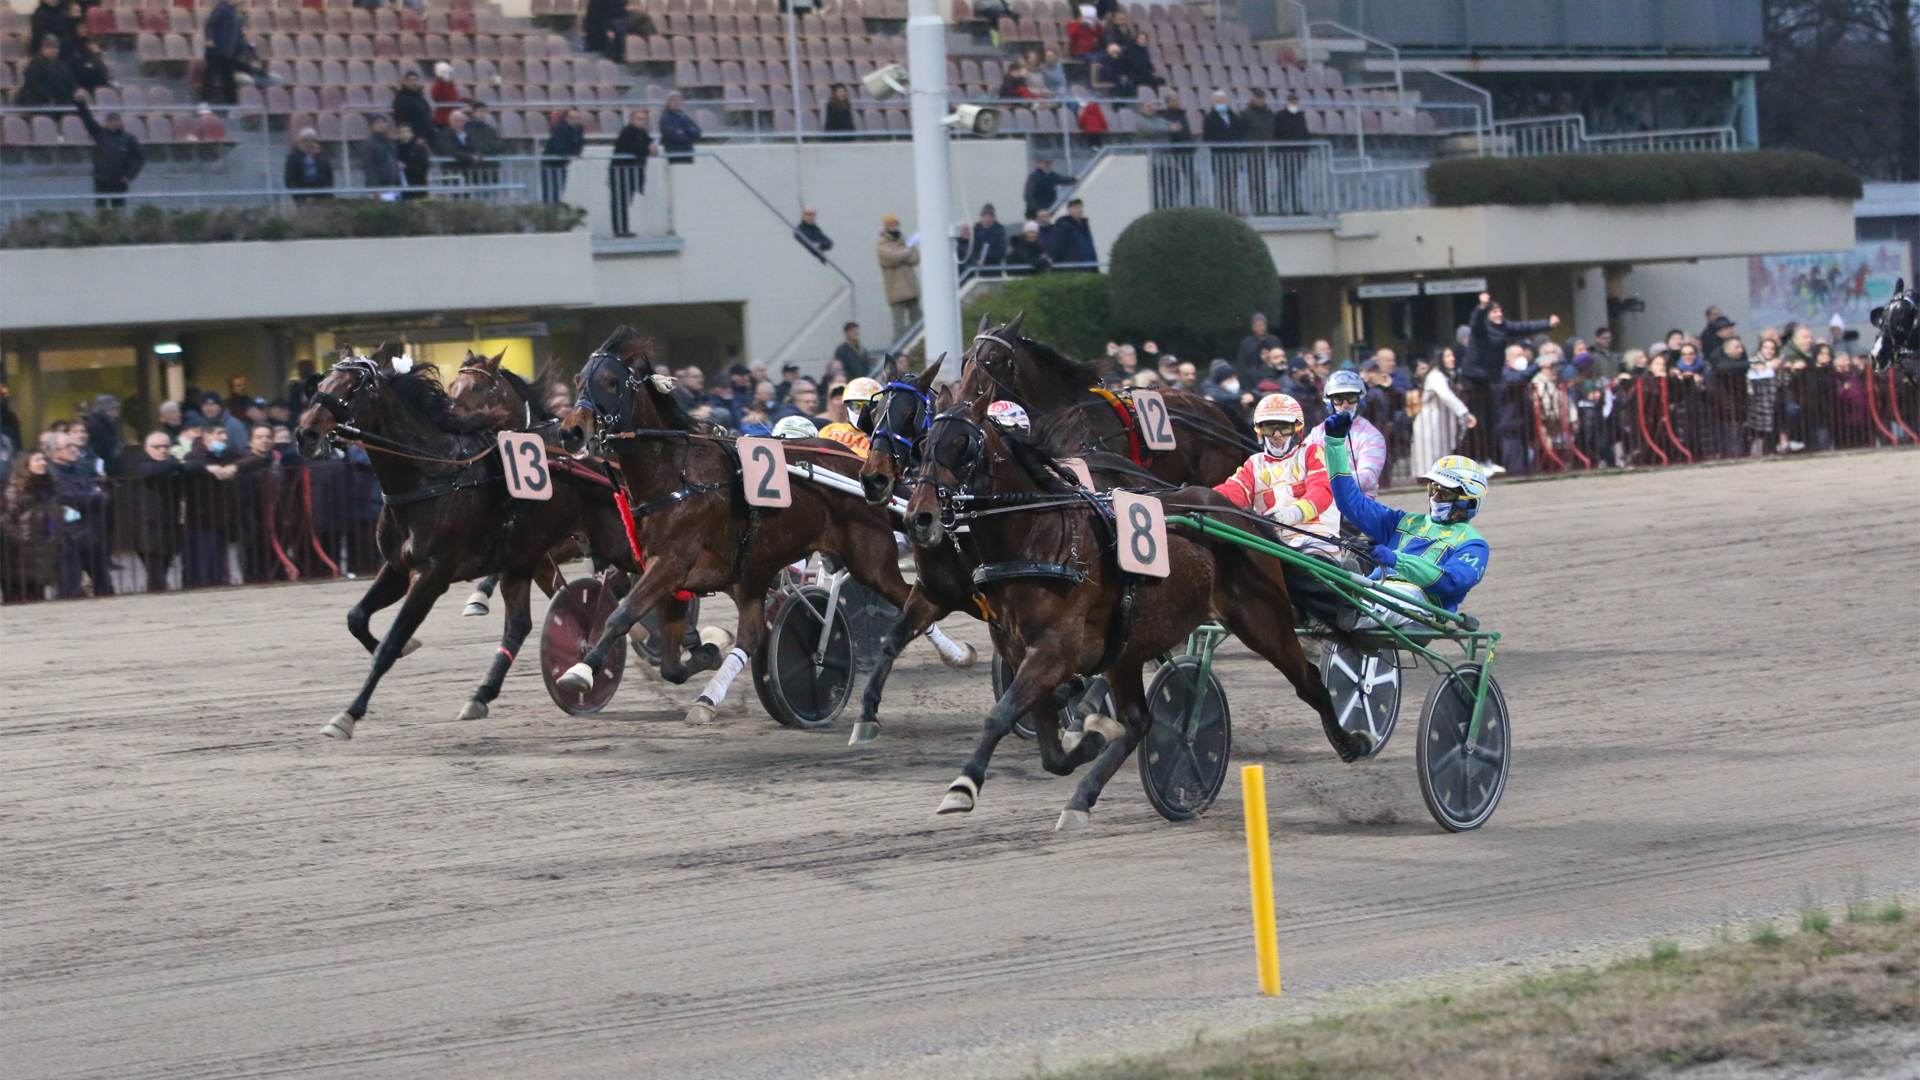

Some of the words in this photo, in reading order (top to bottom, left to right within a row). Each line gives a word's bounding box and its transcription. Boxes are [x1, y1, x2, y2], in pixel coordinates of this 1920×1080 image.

[1138, 398, 1174, 443] 12
[503, 439, 548, 491] 13
[752, 445, 781, 499] 2
[1128, 502, 1157, 565] 8
